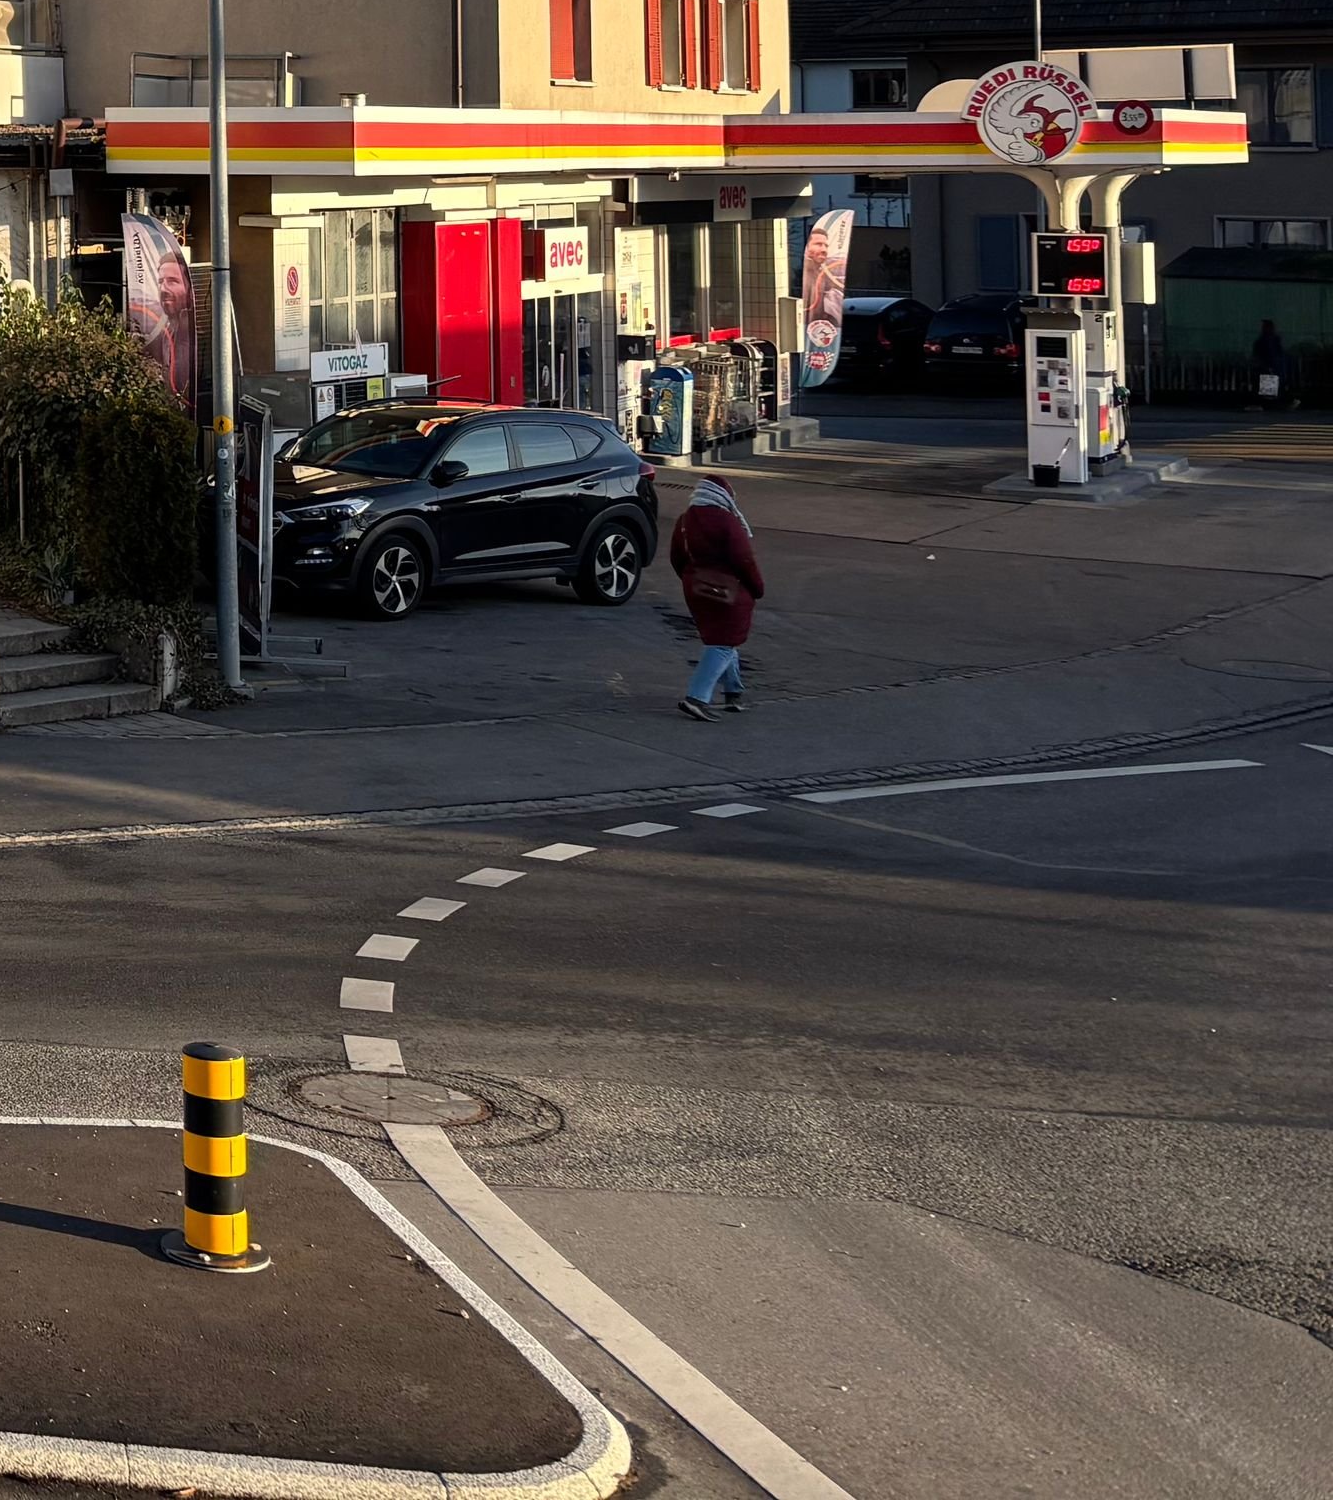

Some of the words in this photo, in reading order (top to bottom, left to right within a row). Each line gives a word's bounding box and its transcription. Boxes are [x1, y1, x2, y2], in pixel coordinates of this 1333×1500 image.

[967, 68, 1017, 118] RUEDI
[1023, 63, 1094, 117] RÜSSEL
[719, 185, 747, 209] avec
[550, 240, 583, 268] avec
